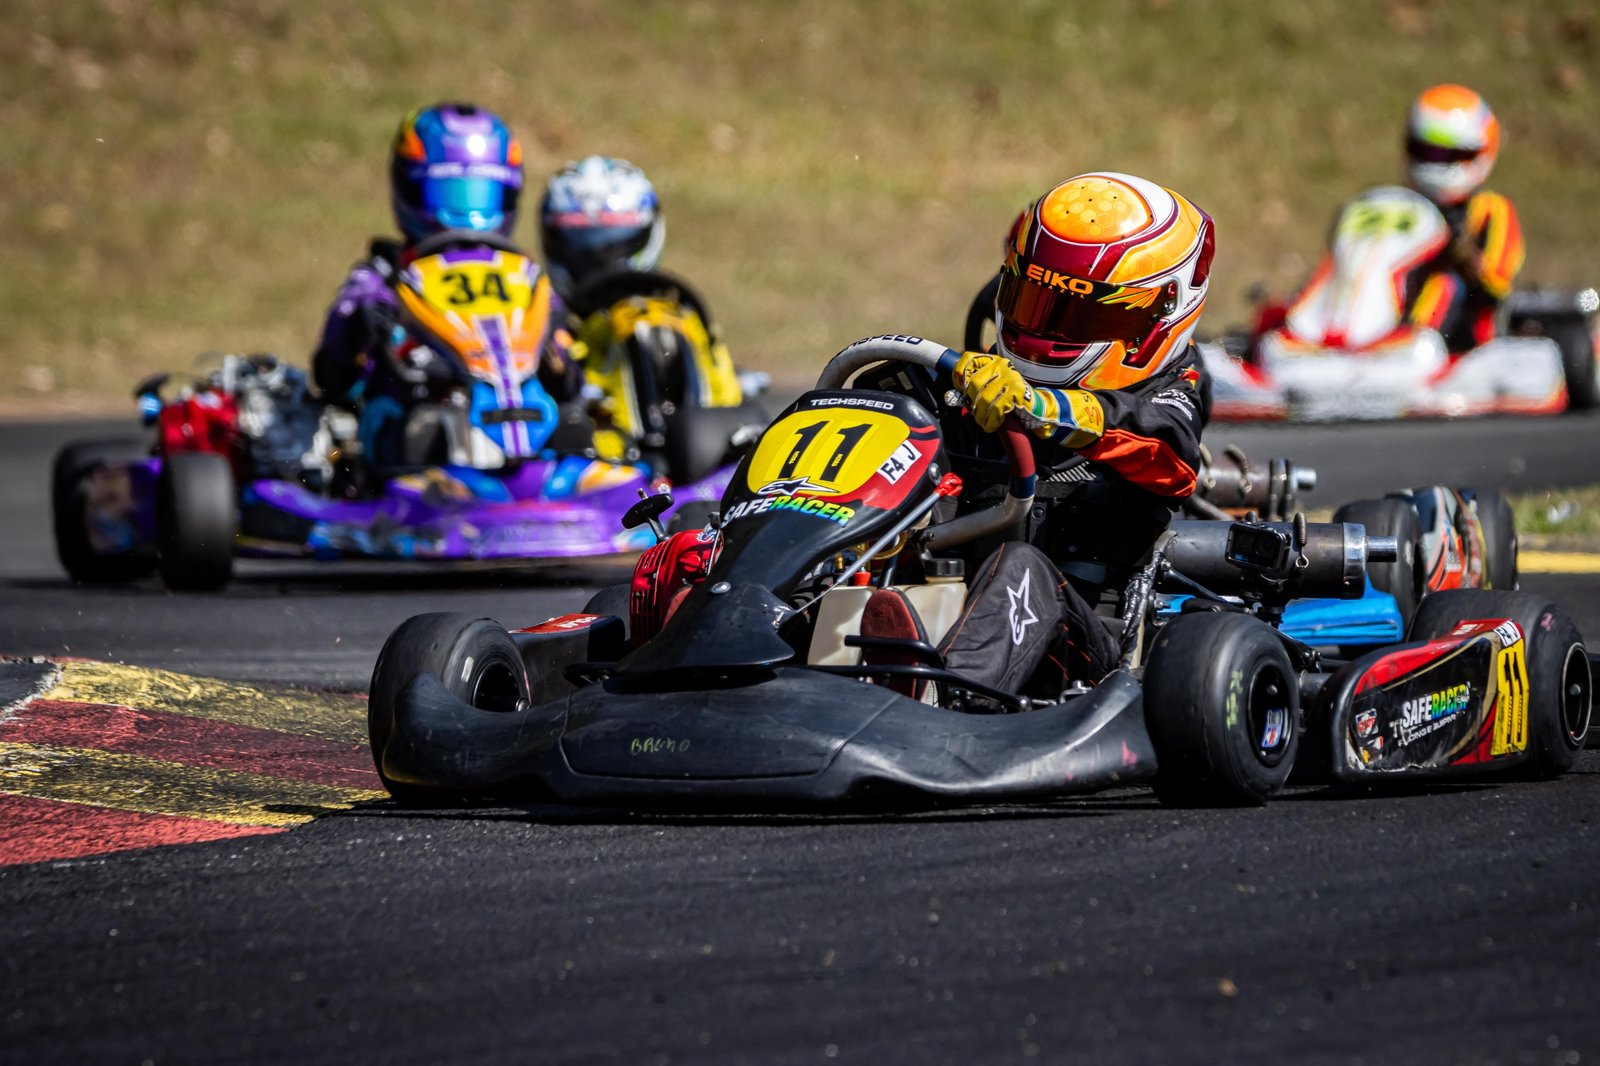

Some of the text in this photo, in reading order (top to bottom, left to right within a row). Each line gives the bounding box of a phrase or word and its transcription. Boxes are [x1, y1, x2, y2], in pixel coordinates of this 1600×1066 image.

[441, 271, 512, 305] 34
[1026, 263, 1094, 295] EIKO
[810, 397, 895, 411] TECHSPEED
[777, 420, 874, 483] 11
[881, 443, 917, 482] F4 J
[721, 495, 856, 529] SAFERACER
